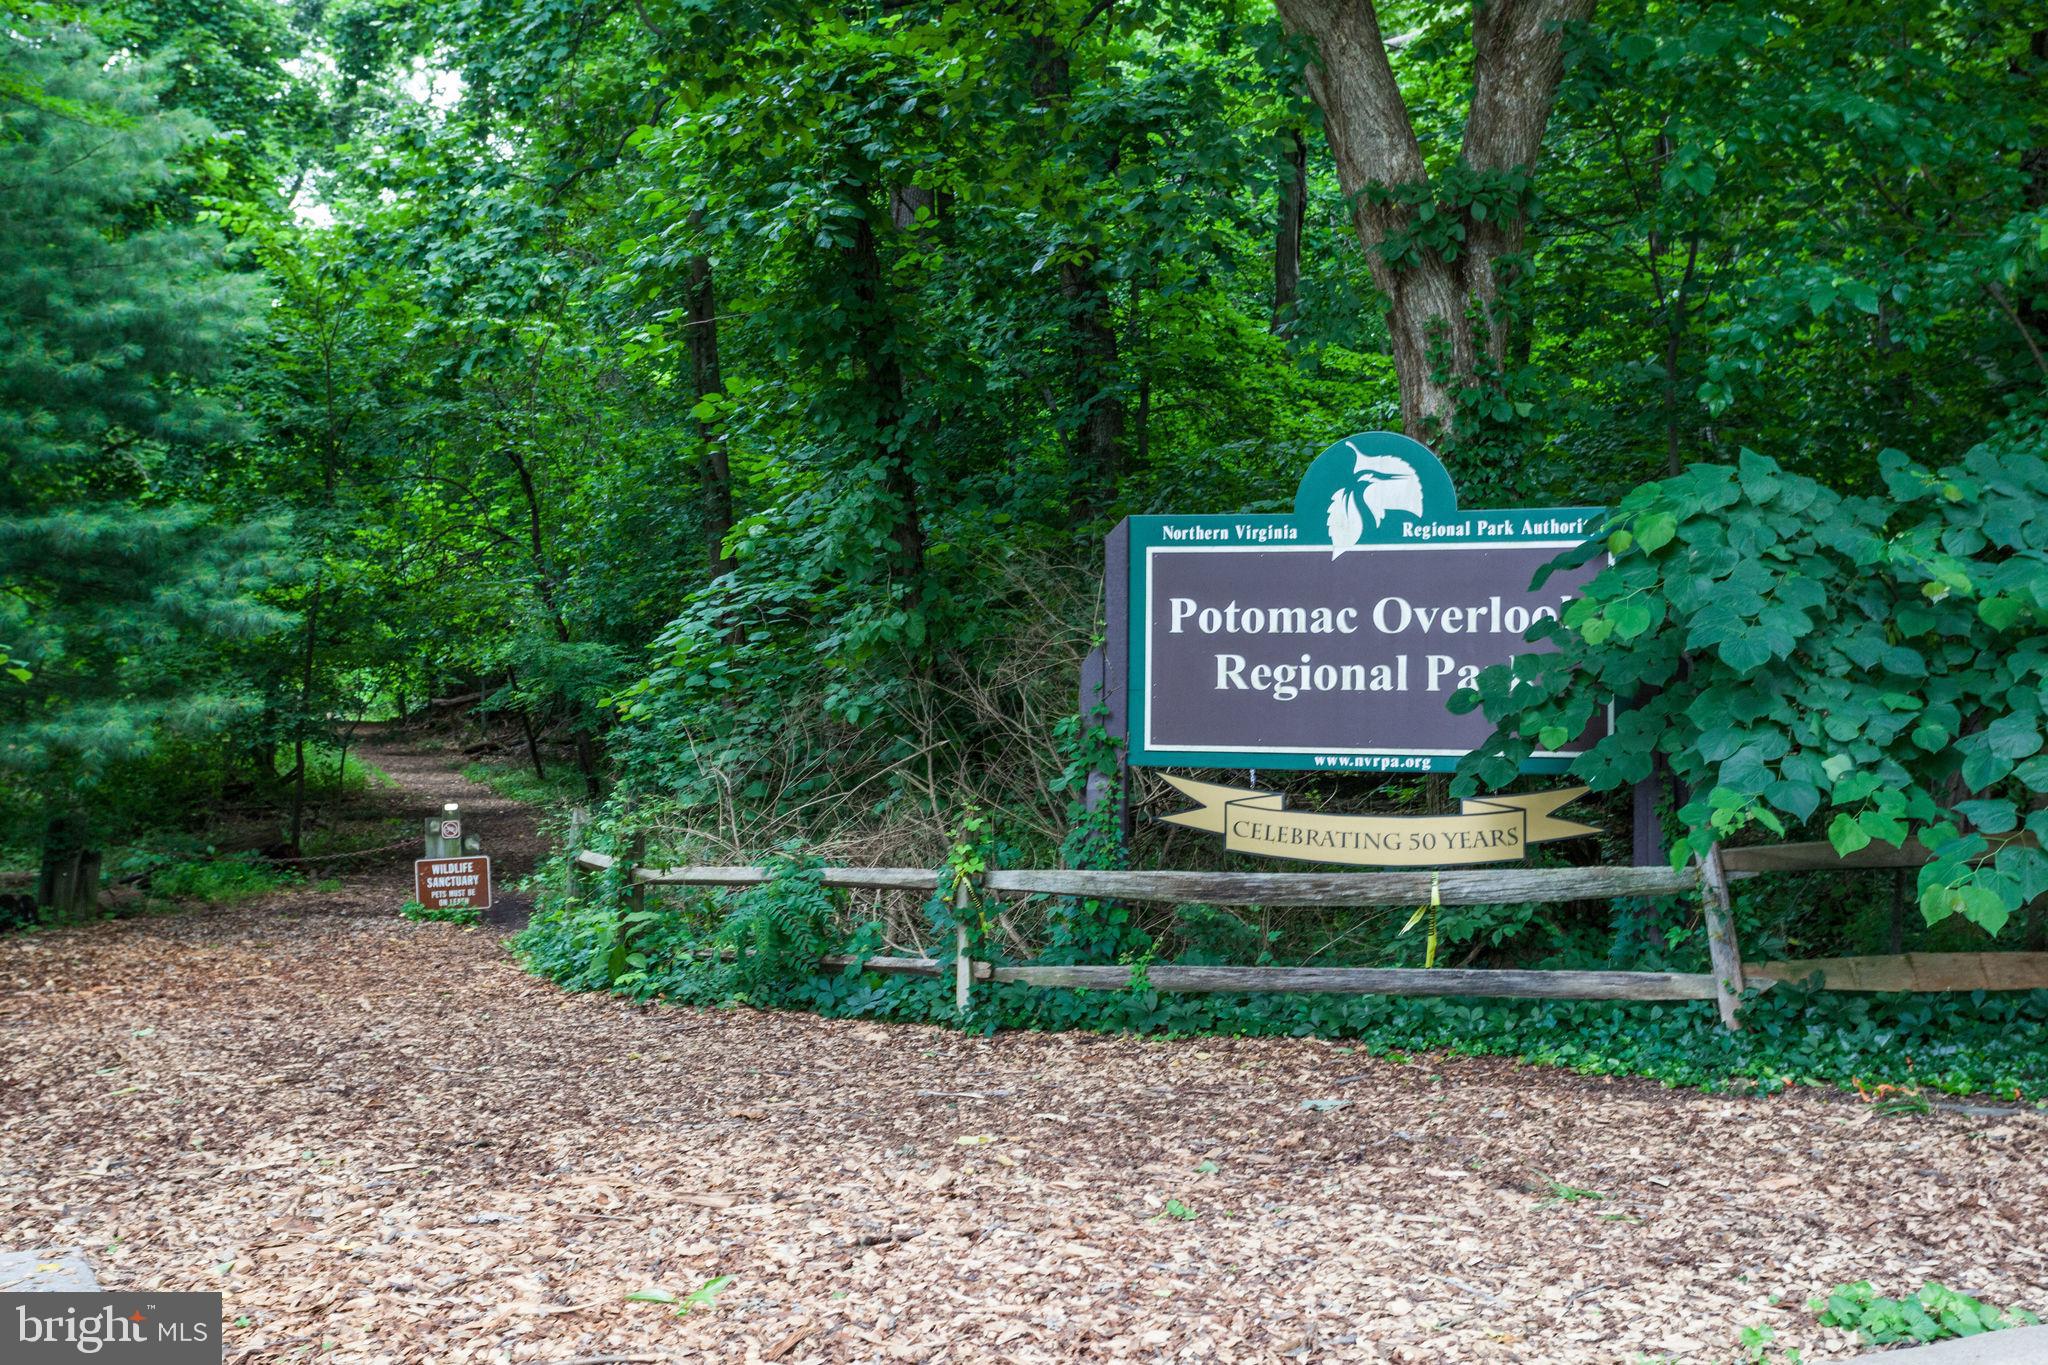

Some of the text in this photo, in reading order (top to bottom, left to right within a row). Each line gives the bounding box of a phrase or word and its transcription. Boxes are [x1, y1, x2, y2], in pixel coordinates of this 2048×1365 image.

[1162, 523, 1298, 543] Northern Virginia
[1402, 517, 1595, 539] Regional Park Authori
[1168, 595, 1575, 635] Potomac Overloo
[1214, 653, 1535, 701] Regional Pa
[1314, 755, 1432, 771] www.nvrpa.org
[1232, 819, 1519, 851] CELEBRATING 50 YEARS
[432, 862, 473, 874] WILDLIFE
[427, 875, 479, 888] SANCTUARY
[431, 890, 448, 899] PETS
[448, 889, 466, 898] MUST
